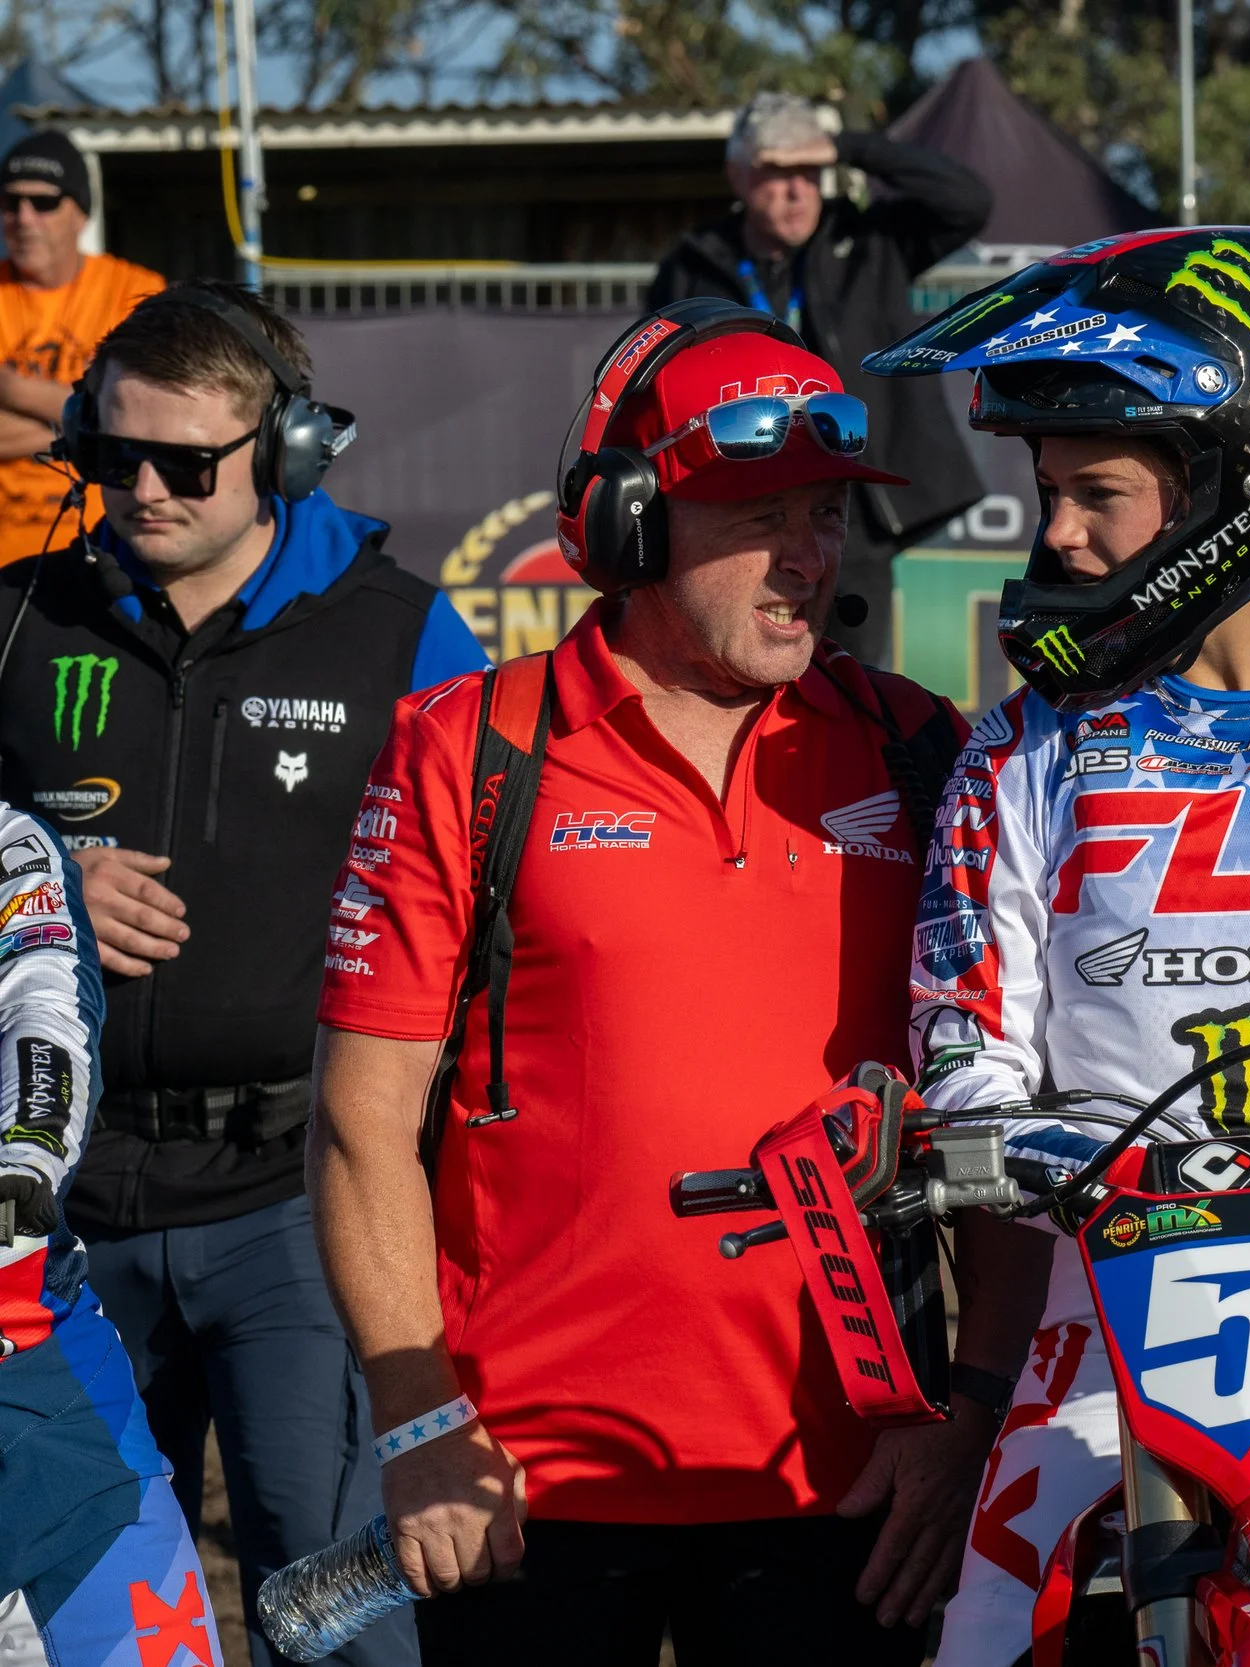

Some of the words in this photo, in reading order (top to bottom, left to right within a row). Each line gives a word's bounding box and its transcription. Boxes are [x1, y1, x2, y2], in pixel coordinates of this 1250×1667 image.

[986, 314, 1106, 357] apdesigns
[635, 518, 645, 567] MOTOROLA
[266, 698, 346, 724] YAMAHA
[250, 719, 341, 733] RACING
[1144, 728, 1241, 754] PROGRESSIVE
[363, 783, 403, 802] ONDA
[549, 811, 657, 846] HRC
[351, 843, 391, 865] boost
[600, 841, 650, 849] RACING
[821, 840, 915, 865] HONDA
[22, 894, 52, 915] ALL
[329, 925, 381, 947] FLY
[26, 1042, 56, 1120] MONSTER
[1103, 1219, 1147, 1239] PENRITE
[1155, 1202, 1177, 1211] PRO
[779, 1152, 897, 1395] SCOTT
